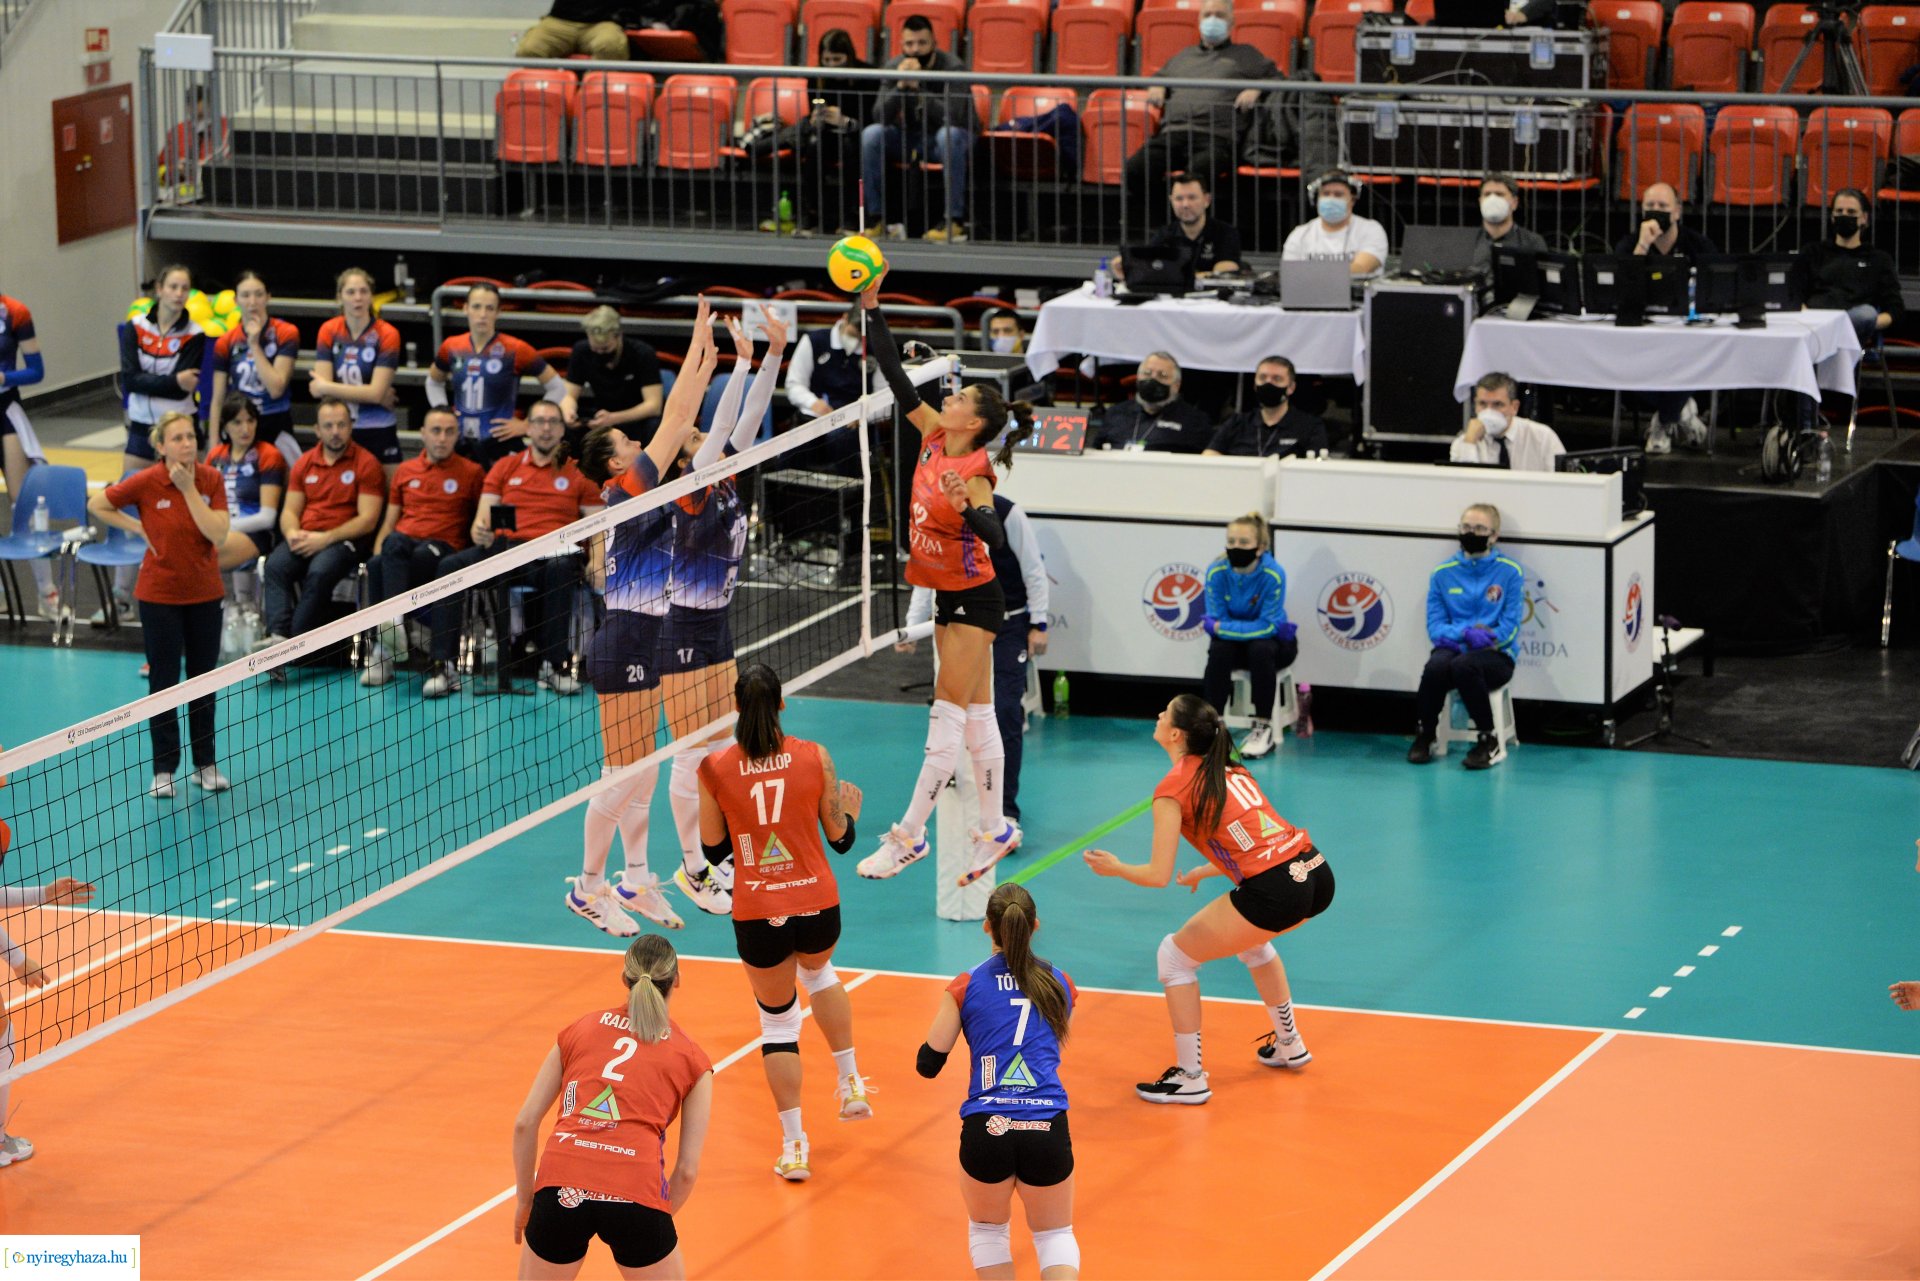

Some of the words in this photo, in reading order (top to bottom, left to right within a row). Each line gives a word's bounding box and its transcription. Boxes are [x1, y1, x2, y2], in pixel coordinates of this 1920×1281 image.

[462, 376, 485, 410] 11
[913, 502, 928, 526] 12
[1161, 564, 1200, 576] FATUM
[1335, 573, 1376, 586] FATUM
[677, 648, 694, 664] 17
[625, 664, 645, 683] 20
[85, 722, 102, 734] Champions
[102, 719, 114, 728] League
[114, 715, 124, 723] Volley
[123, 710, 131, 719] 2022
[749, 777, 785, 826] 17
[1226, 773, 1263, 811] 10
[766, 876, 818, 891] BESTRONG
[1010, 998, 1032, 1046] 7
[601, 1036, 638, 1082] 2
[996, 1097, 1054, 1106] BESTRONG
[574, 1139, 636, 1156] BESTRONG
